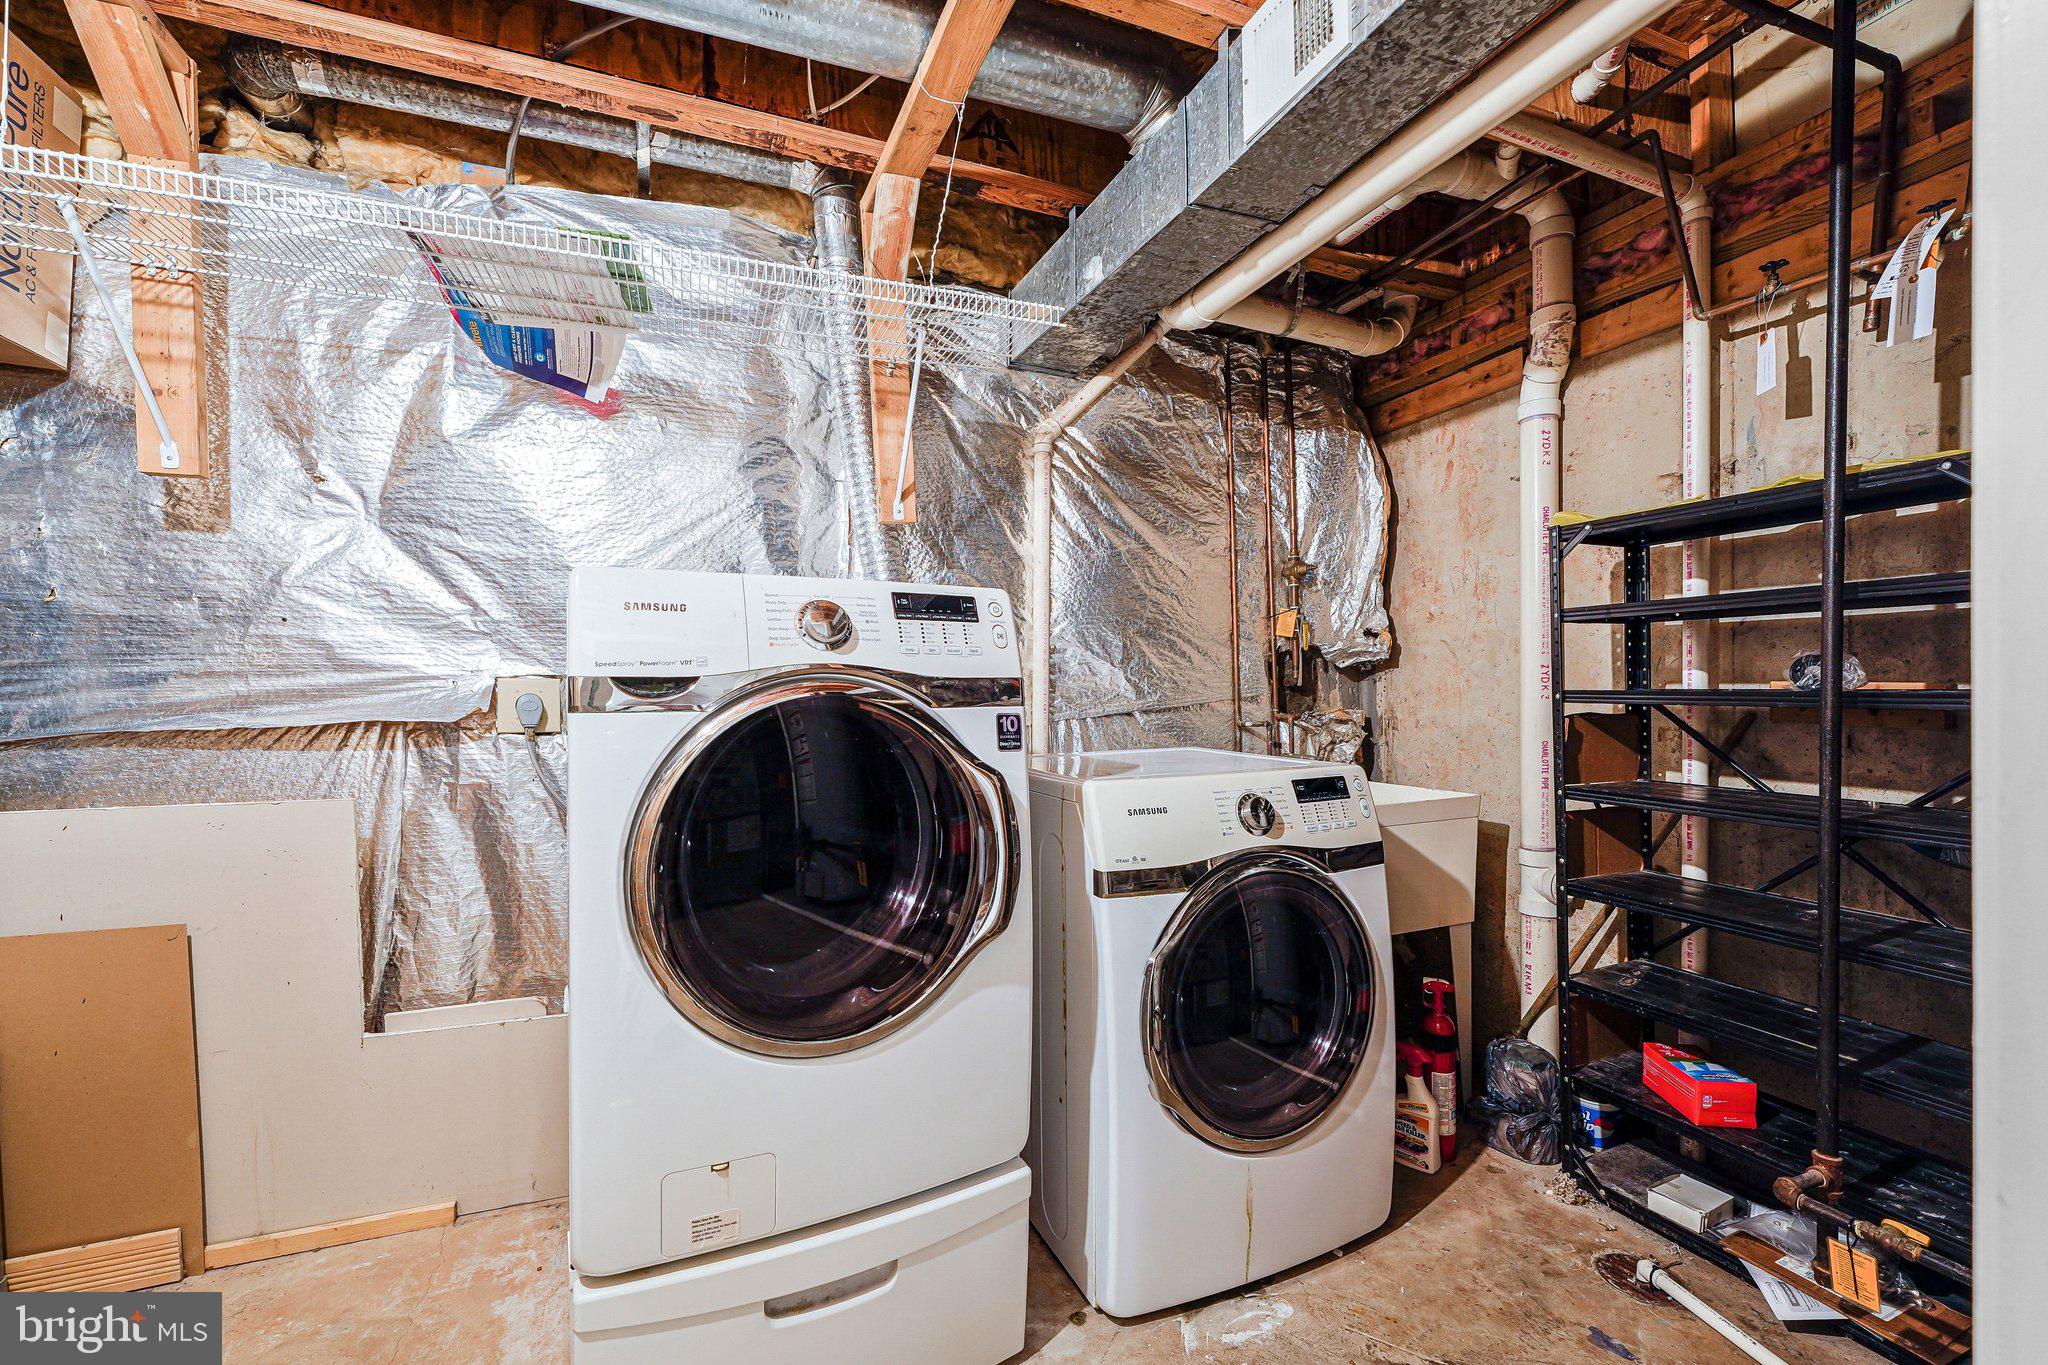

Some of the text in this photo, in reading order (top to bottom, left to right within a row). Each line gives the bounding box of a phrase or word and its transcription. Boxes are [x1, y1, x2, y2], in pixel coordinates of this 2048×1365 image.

[31, 81, 46, 152] FILTERS
[624, 601, 687, 612] SAMSUNG
[999, 715, 1018, 732] 10
[1541, 740, 1549, 774] CHARLOTTE
[1541, 776, 1550, 790] PIPE
[1127, 806, 1168, 817] SAMSUNG
